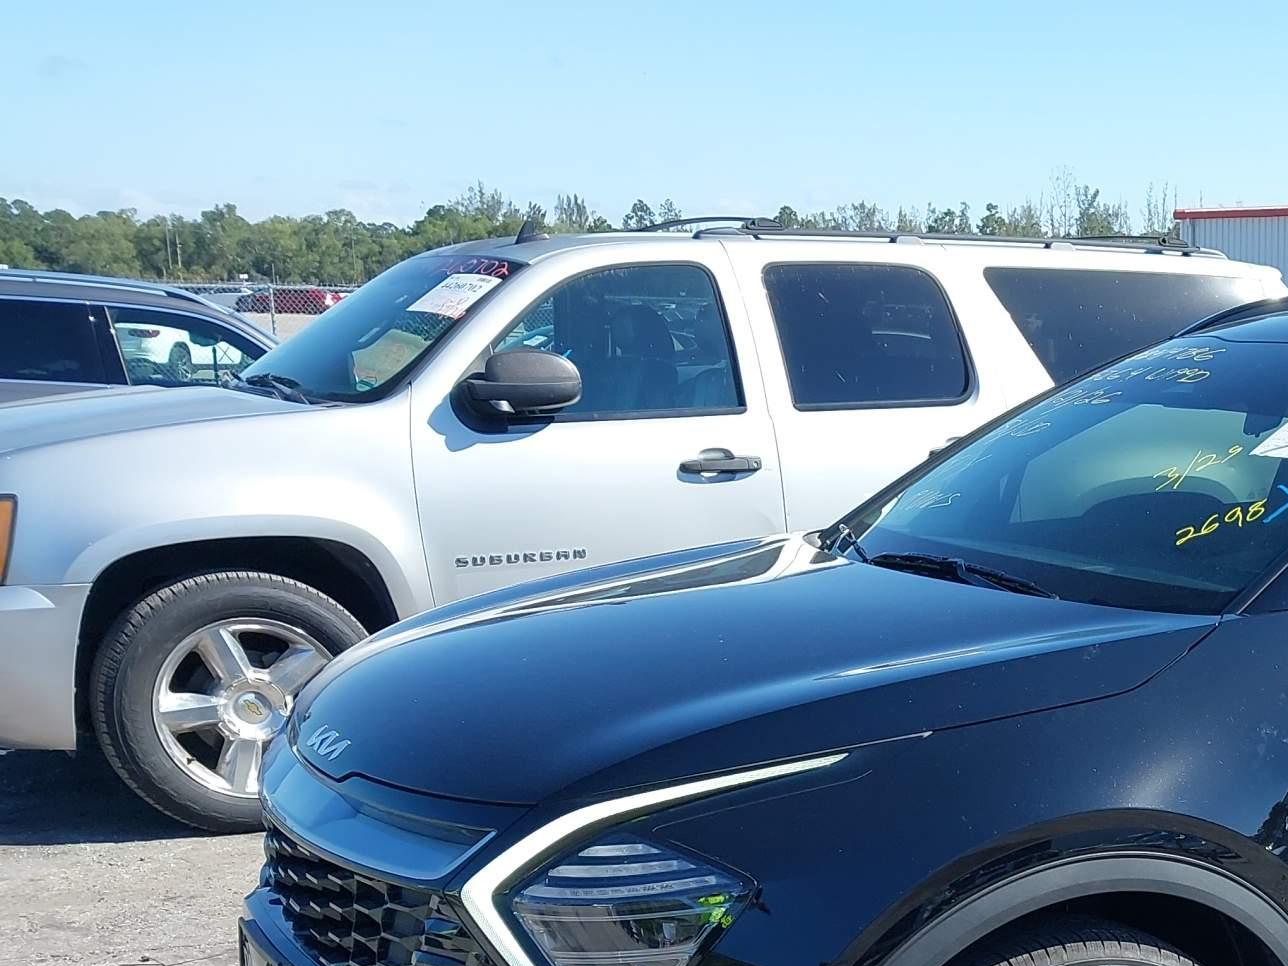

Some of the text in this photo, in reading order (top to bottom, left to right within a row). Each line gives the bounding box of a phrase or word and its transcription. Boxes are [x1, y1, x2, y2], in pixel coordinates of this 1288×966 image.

[1153, 445, 1243, 491] 3/29
[1176, 498, 1267, 546] 2698
[455, 549, 586, 568] SUBURBAN
[306, 724, 351, 760] KIA
